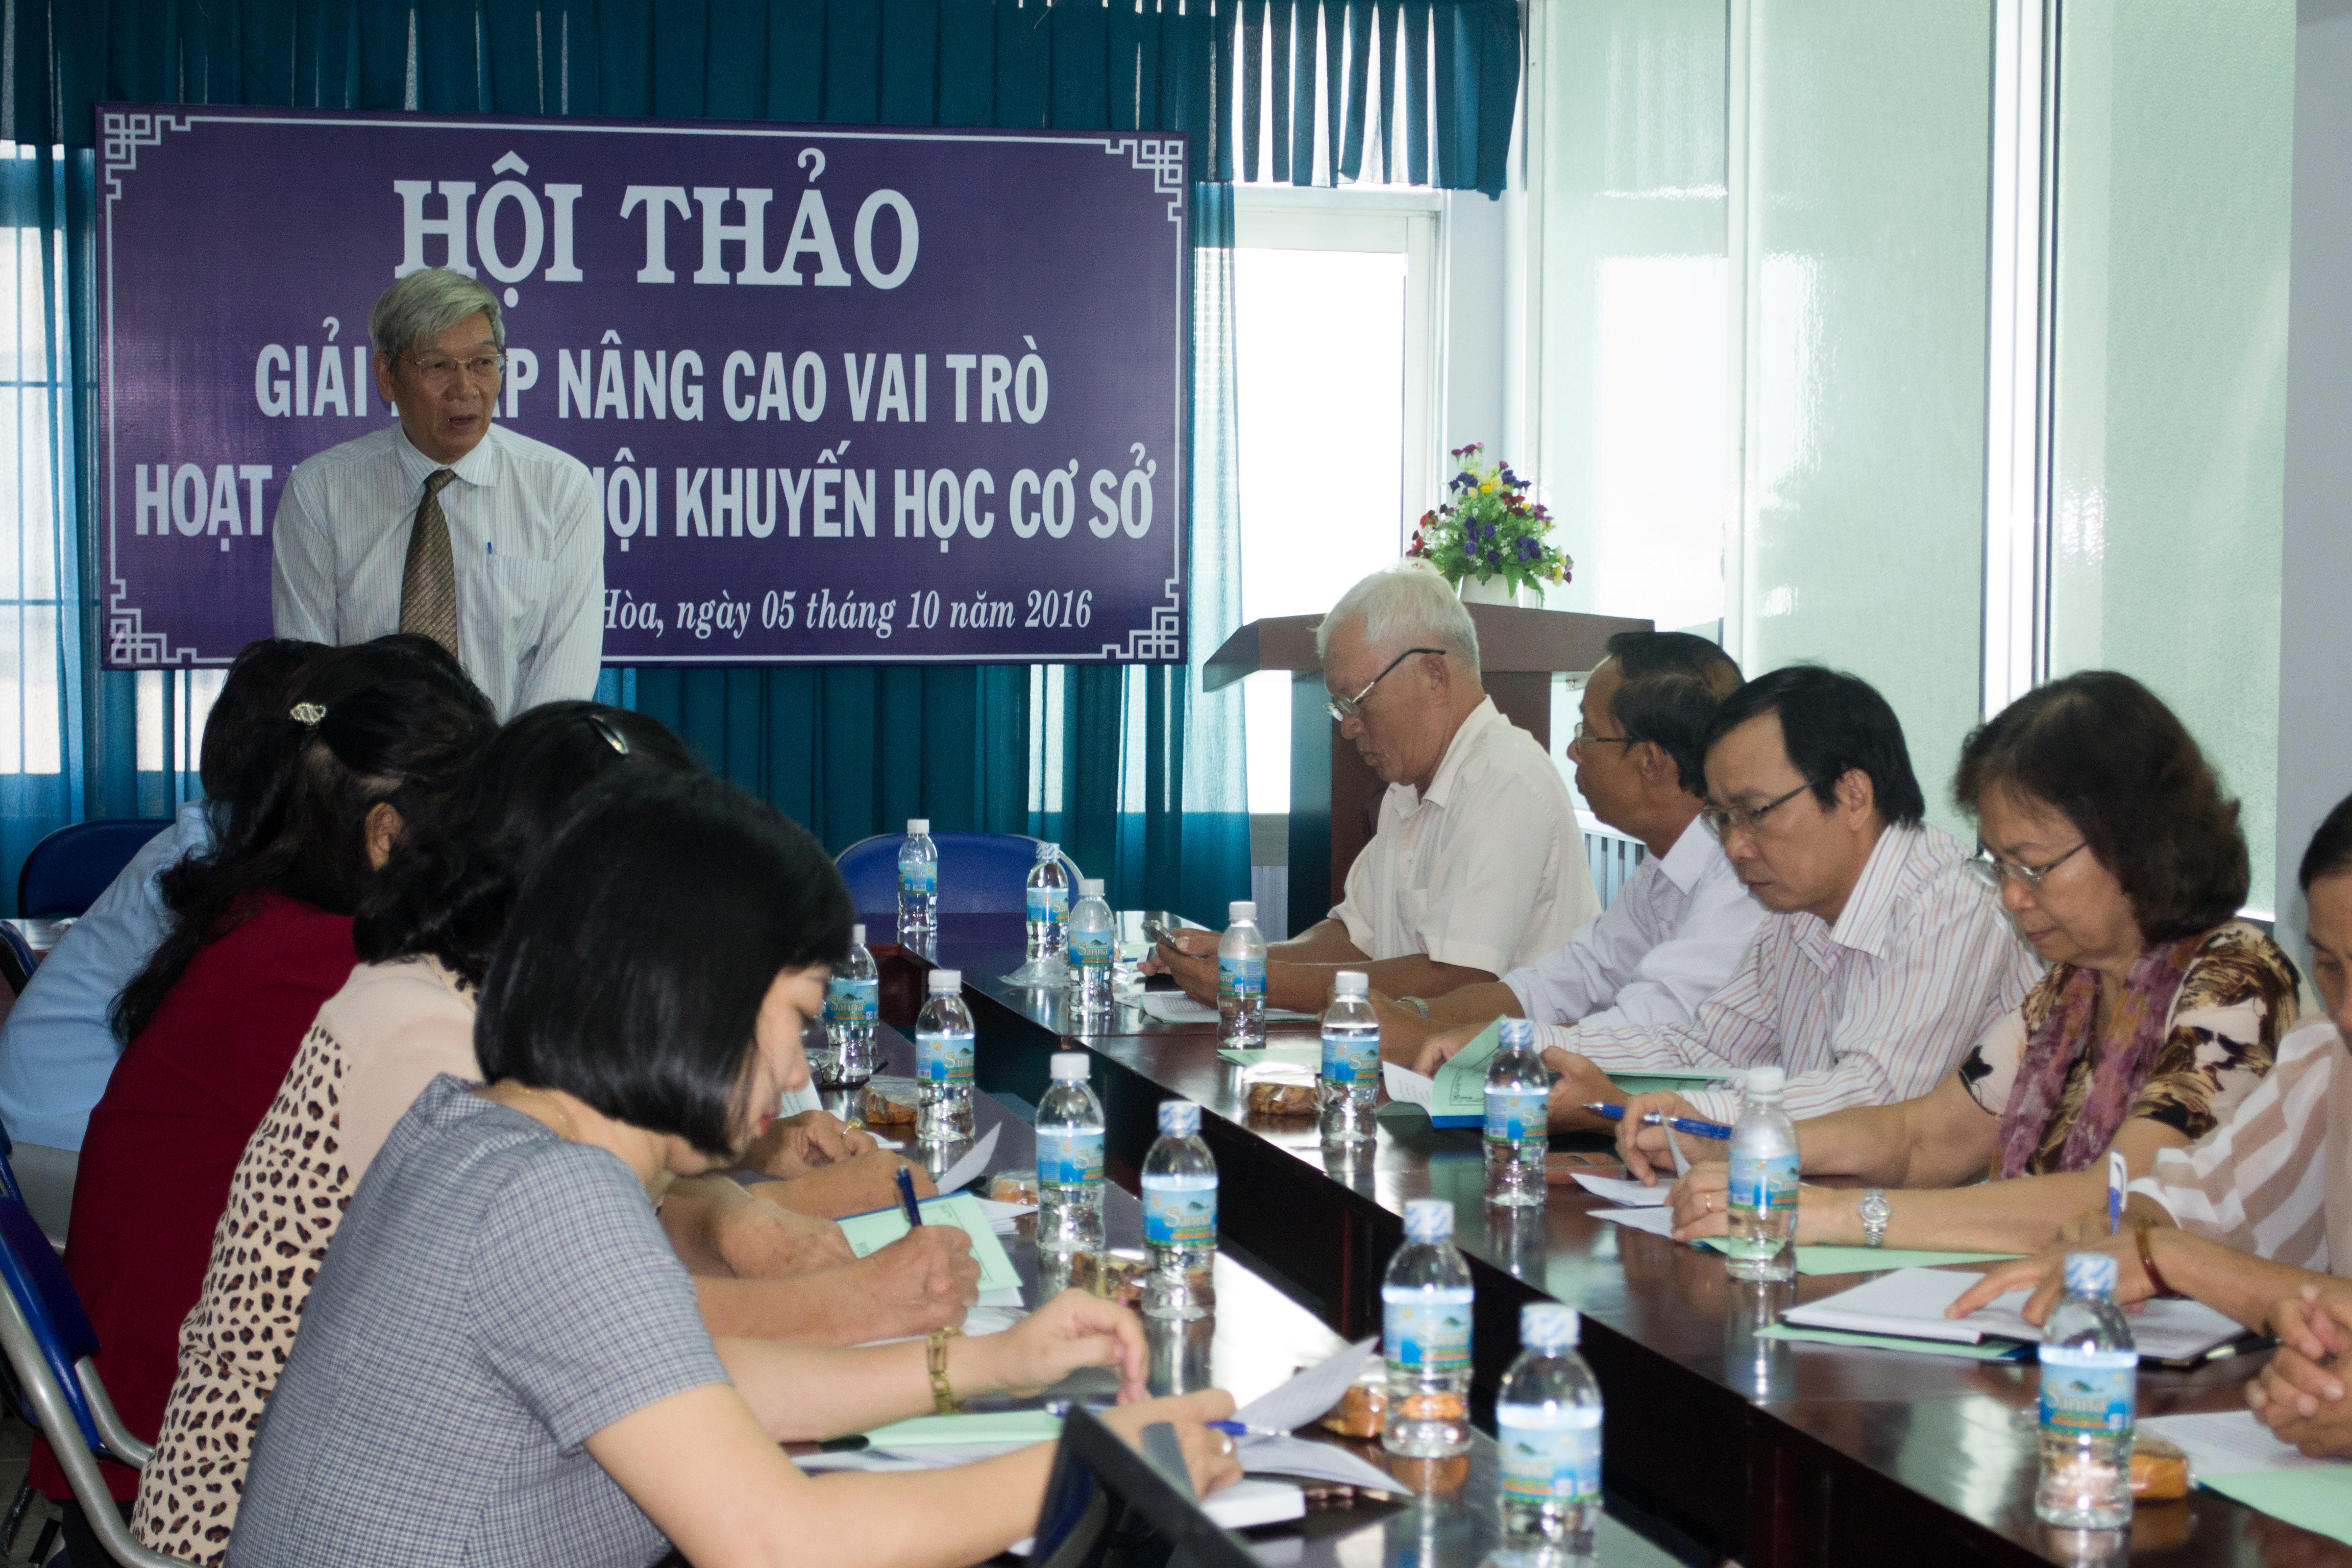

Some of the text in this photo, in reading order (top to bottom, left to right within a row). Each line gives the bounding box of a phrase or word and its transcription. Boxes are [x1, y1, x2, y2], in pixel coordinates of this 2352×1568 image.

[394, 148, 919, 308] HỘI THẢO
[255, 316, 367, 417] GIẢI
[559, 330, 703, 421] NÂNG
[722, 350, 827, 422] CAO
[843, 352, 927, 423] VAI
[946, 335, 1049, 424] TRÒ
[135, 463, 273, 552] HOẠT
[676, 440, 876, 538] KHUYẾN
[894, 468, 995, 553] HỌC
[1009, 458, 1080, 539] CƠ
[1089, 443, 1156, 540] SỞ
[677, 590, 751, 639] ngày
[762, 590, 796, 629] 05
[806, 588, 896, 639] tháng
[906, 590, 940, 629] 10
[949, 591, 1016, 629] năm
[1024, 589, 1093, 628] 2016
[1078, 942, 1109, 955] Sanna
[829, 997, 864, 1011] Sanna
